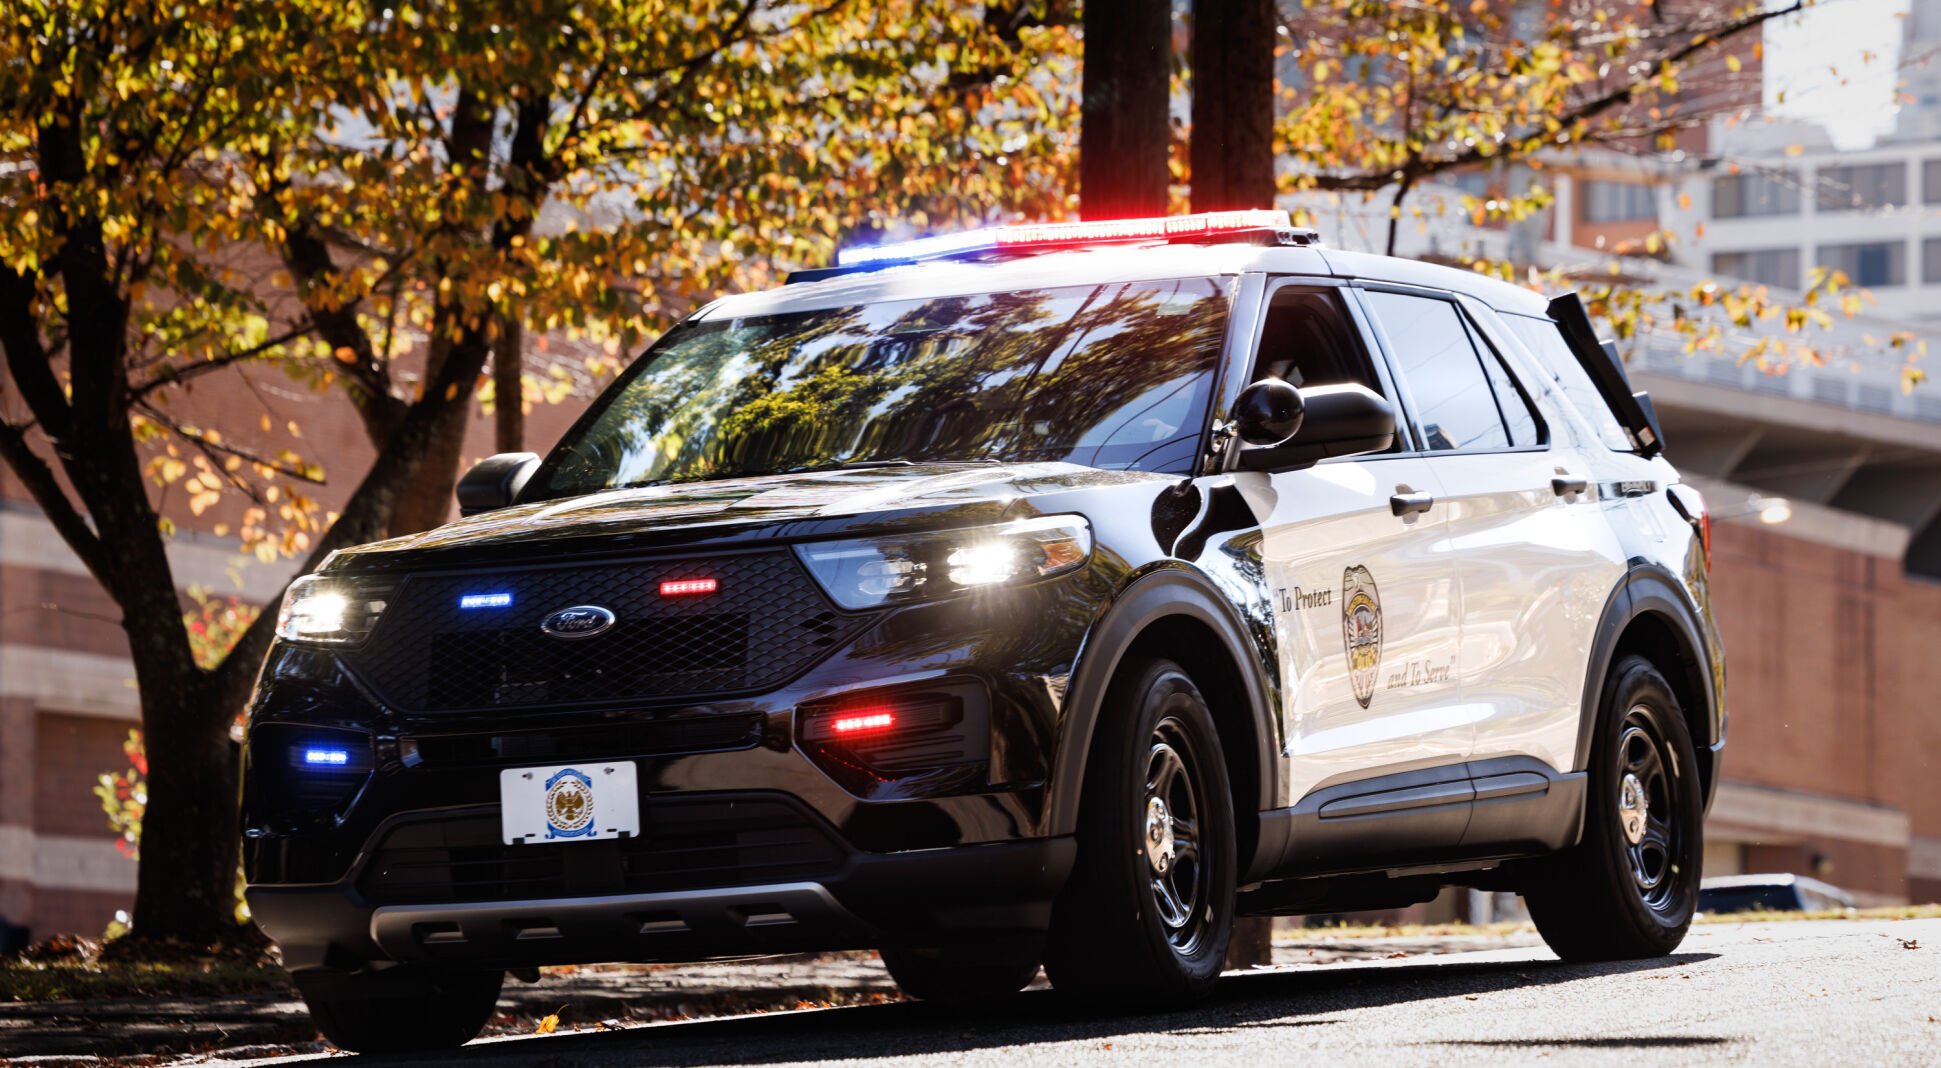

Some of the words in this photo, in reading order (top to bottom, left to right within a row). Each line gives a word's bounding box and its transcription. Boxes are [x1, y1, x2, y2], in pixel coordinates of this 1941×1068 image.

[1294, 586, 1331, 610] Protect
[556, 611, 598, 630] Ford
[1387, 662, 1408, 689] and
[1410, 662, 1422, 686] To
